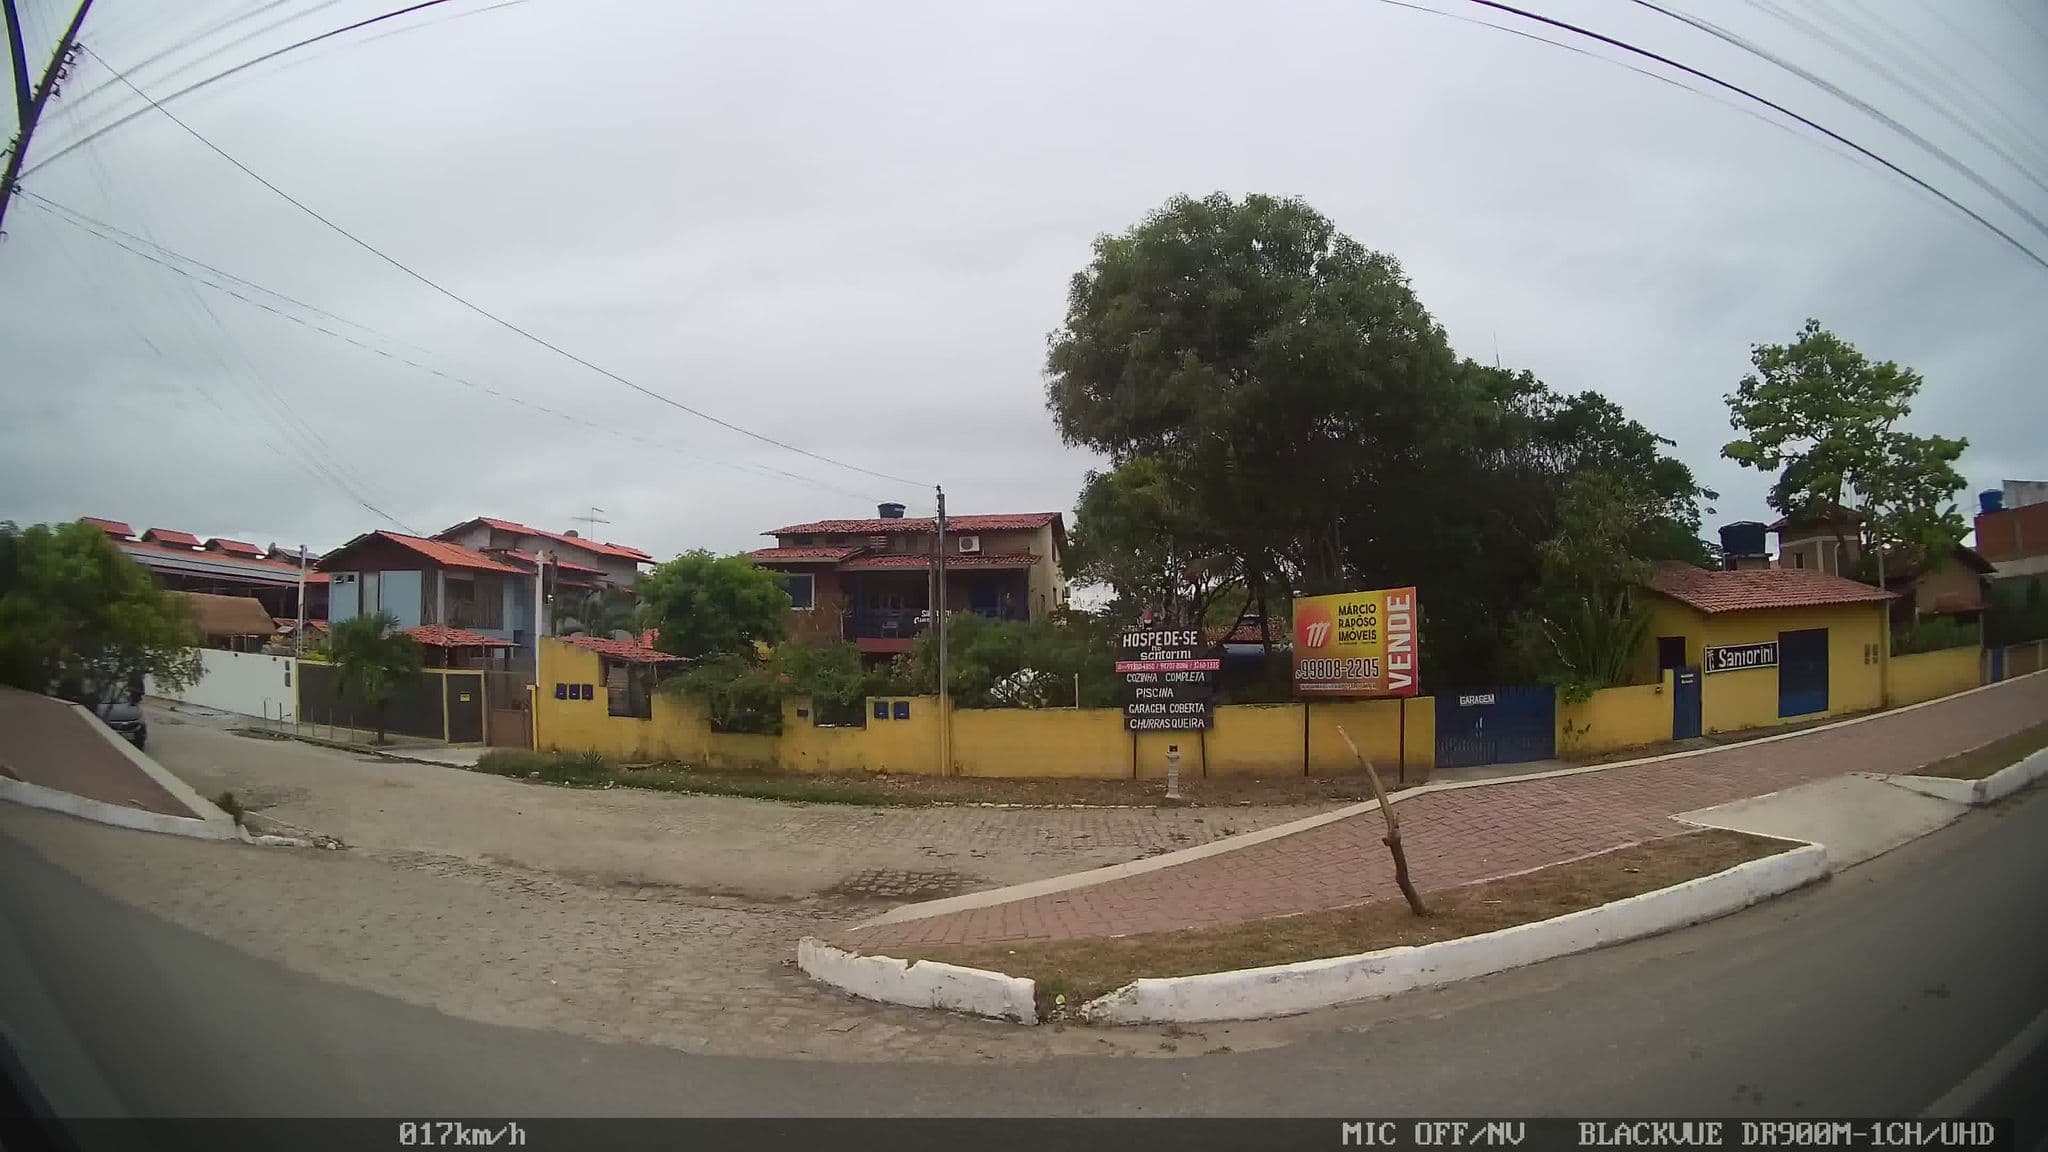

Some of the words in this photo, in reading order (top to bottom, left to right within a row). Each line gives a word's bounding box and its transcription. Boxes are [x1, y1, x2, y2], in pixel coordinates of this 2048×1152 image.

[1338, 602, 1377, 616] MÁRCIO
[1123, 631, 1198, 648] HOSPEDE-SE
[1338, 628, 1377, 642] IMÓVEIS
[1387, 594, 1412, 690] VENDE
[1718, 645, 1774, 668] Santorini
[1300, 657, 1380, 679] 99808-2205
[1126, 673, 1158, 682] COZINHA
[1165, 672, 1205, 682] COMPLETA
[1136, 688, 1174, 698] PISCINA
[1460, 694, 1495, 705] GARAGEM
[1128, 704, 1167, 714] GARAGEM
[1169, 703, 1205, 714] COBERTA
